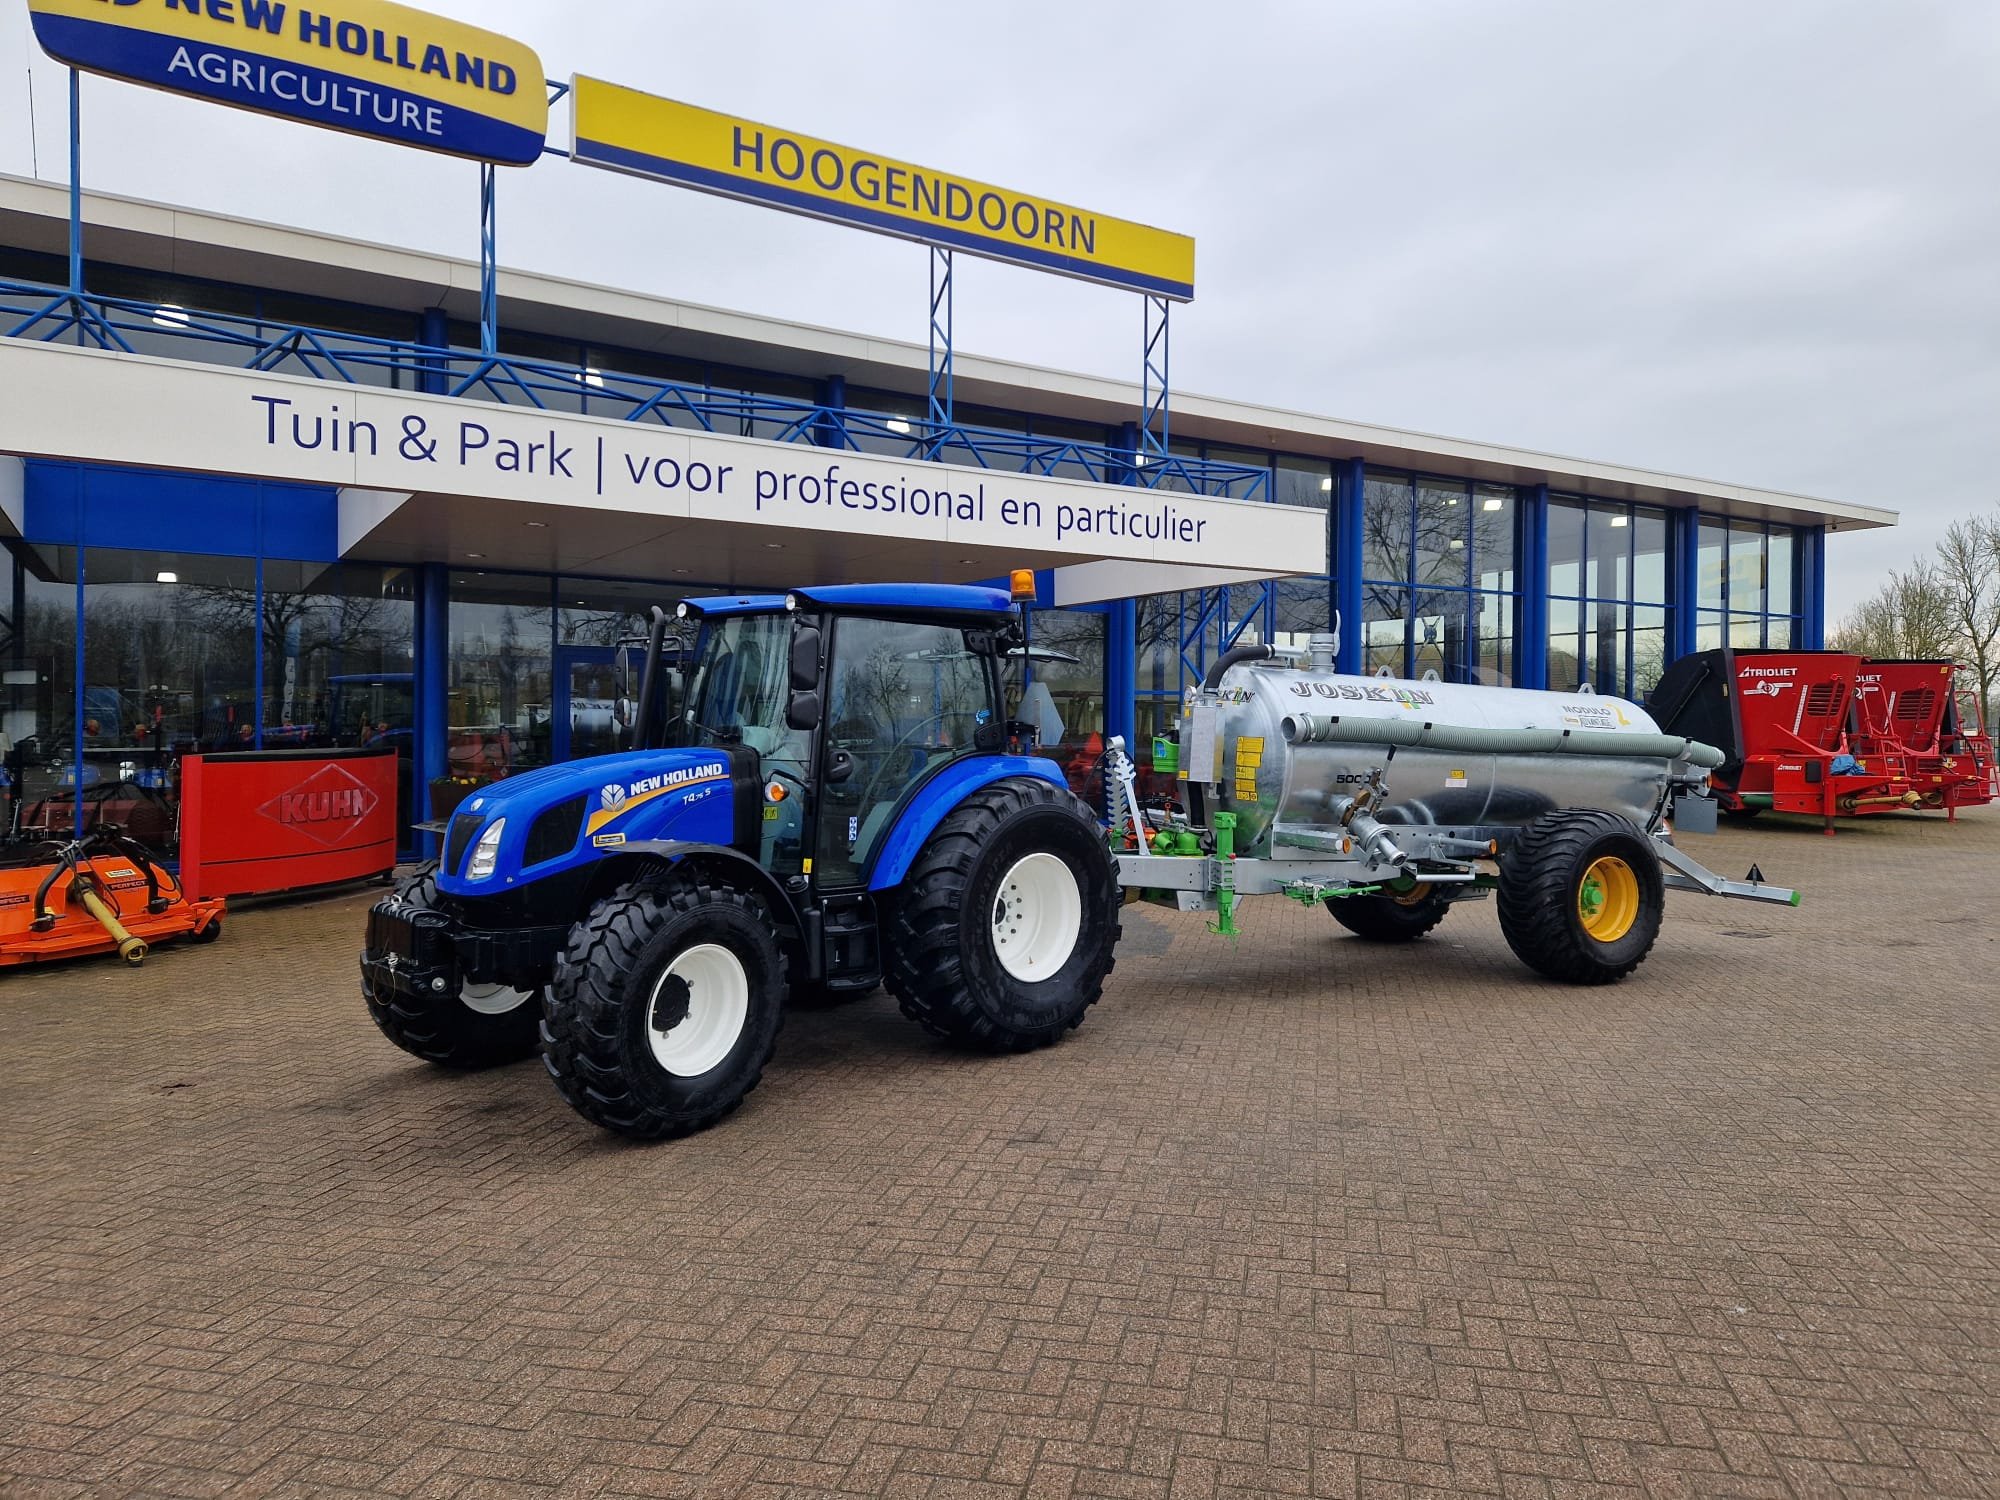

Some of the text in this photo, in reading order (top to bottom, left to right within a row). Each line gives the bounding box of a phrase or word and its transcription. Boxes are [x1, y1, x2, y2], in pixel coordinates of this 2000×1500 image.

[167, 46, 444, 136] AGRICULTURE
[299, 9, 517, 96] HOLLAND
[731, 125, 1096, 255] HOOGENDOORN
[251, 395, 378, 456] Tuin
[398, 414, 437, 464] &
[459, 421, 574, 479] Park
[624, 452, 734, 495] voor
[754, 465, 985, 523] professional
[1000, 498, 1042, 528] en
[1056, 503, 1207, 543] particulier
[1289, 681, 1435, 705] JOSKIN
[280, 789, 368, 824] KUHN
[630, 763, 723, 796] NEW HOLLAND
